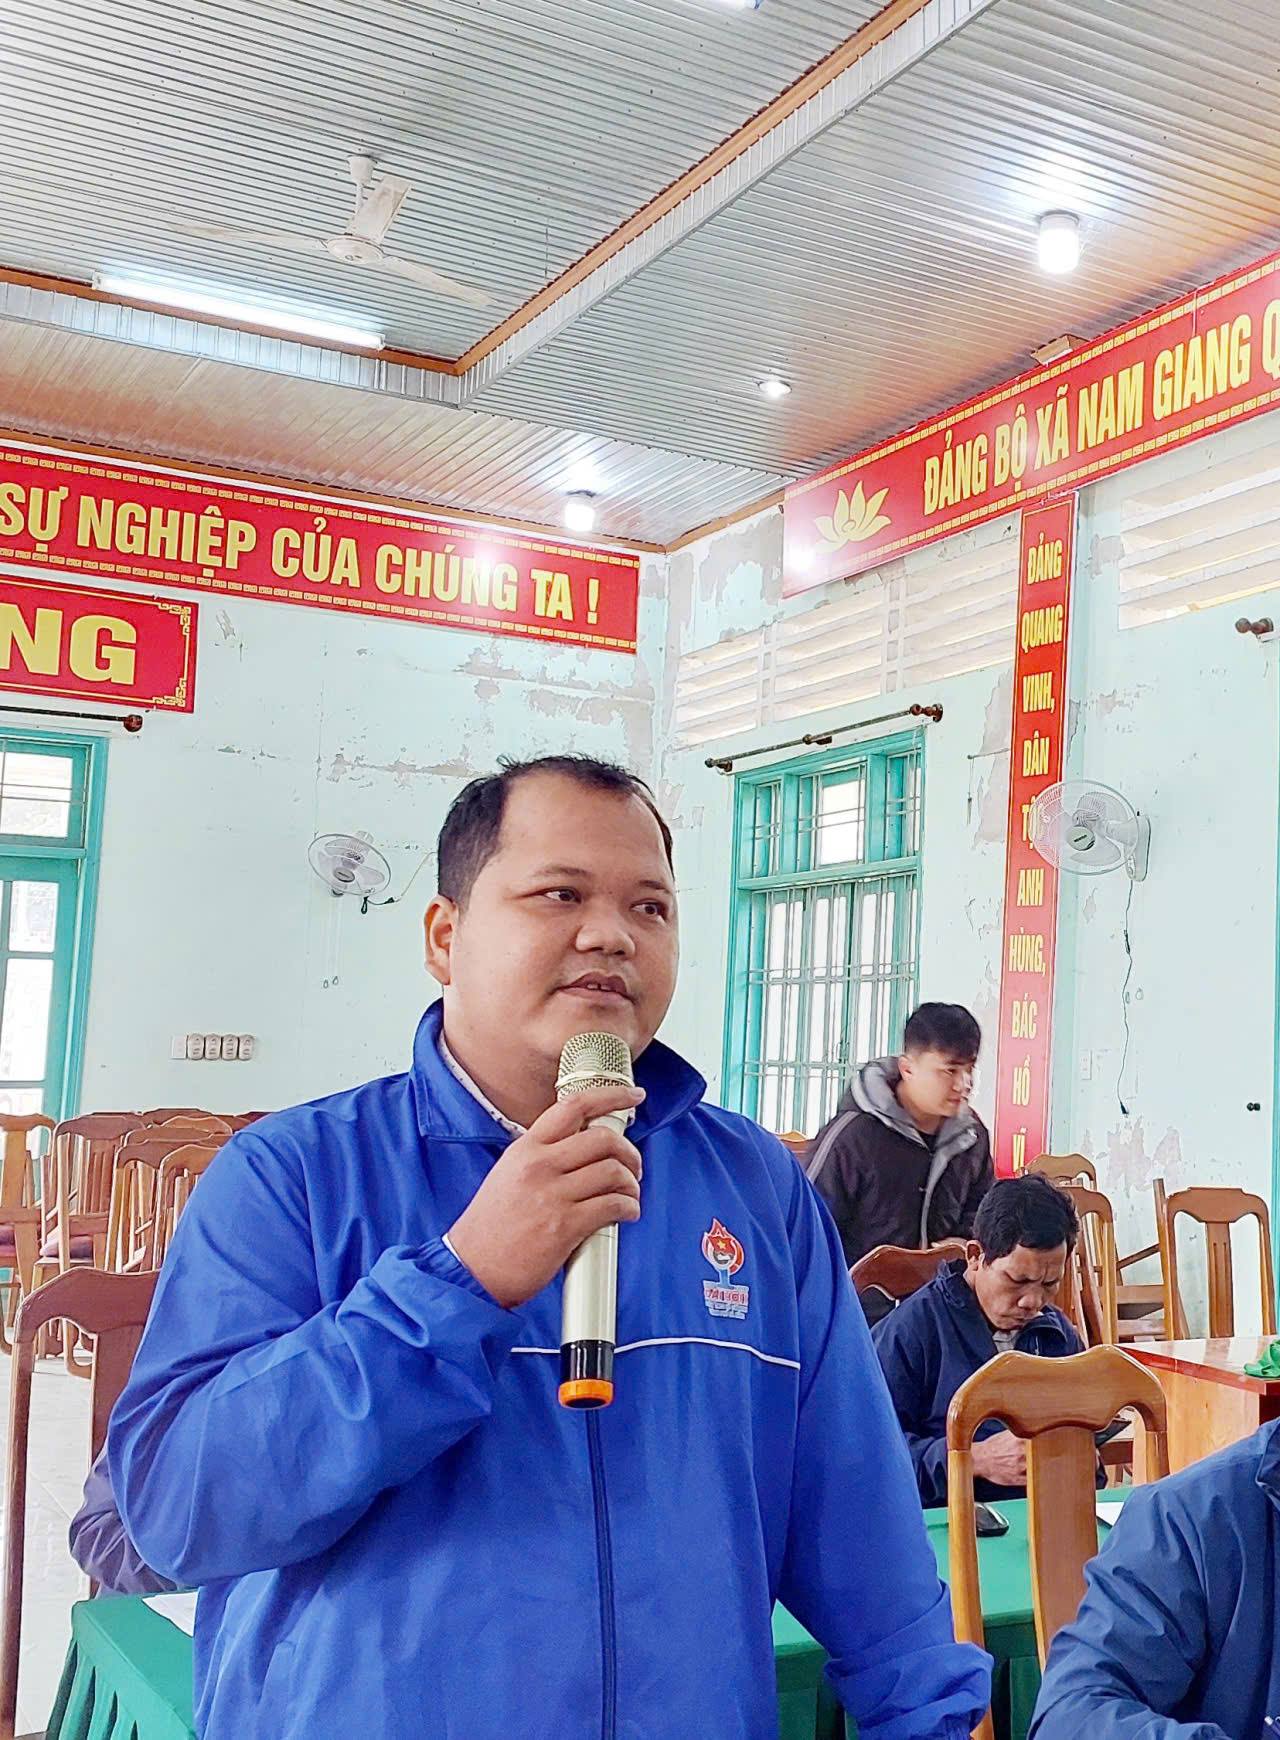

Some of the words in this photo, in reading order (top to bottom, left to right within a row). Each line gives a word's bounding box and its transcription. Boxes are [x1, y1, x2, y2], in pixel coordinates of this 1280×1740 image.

[924, 430, 987, 514] ĐẢNG
[993, 404, 1028, 493] BỘ
[1033, 383, 1071, 470] XÃ
[1077, 361, 1144, 452] NAM
[1152, 314, 1251, 420] GIANG
[0, 483, 68, 553] SỰ
[77, 496, 257, 579] NGHIỆP
[271, 517, 359, 588] CỦA
[375, 541, 517, 610] CHÚNG
[531, 569, 573, 620] TA
[588, 579, 598, 623] !
[1028, 533, 1062, 584] ĐẢNG
[0, 602, 136, 685] NG
[1022, 605, 1062, 652] QUANG
[1024, 672, 1054, 712] VINH,
[1023, 731, 1049, 776] DÂN
[1017, 868, 1044, 906] ANH
[1011, 992, 1037, 1040] BÁC
[1012, 1054, 1032, 1106] HỒ
